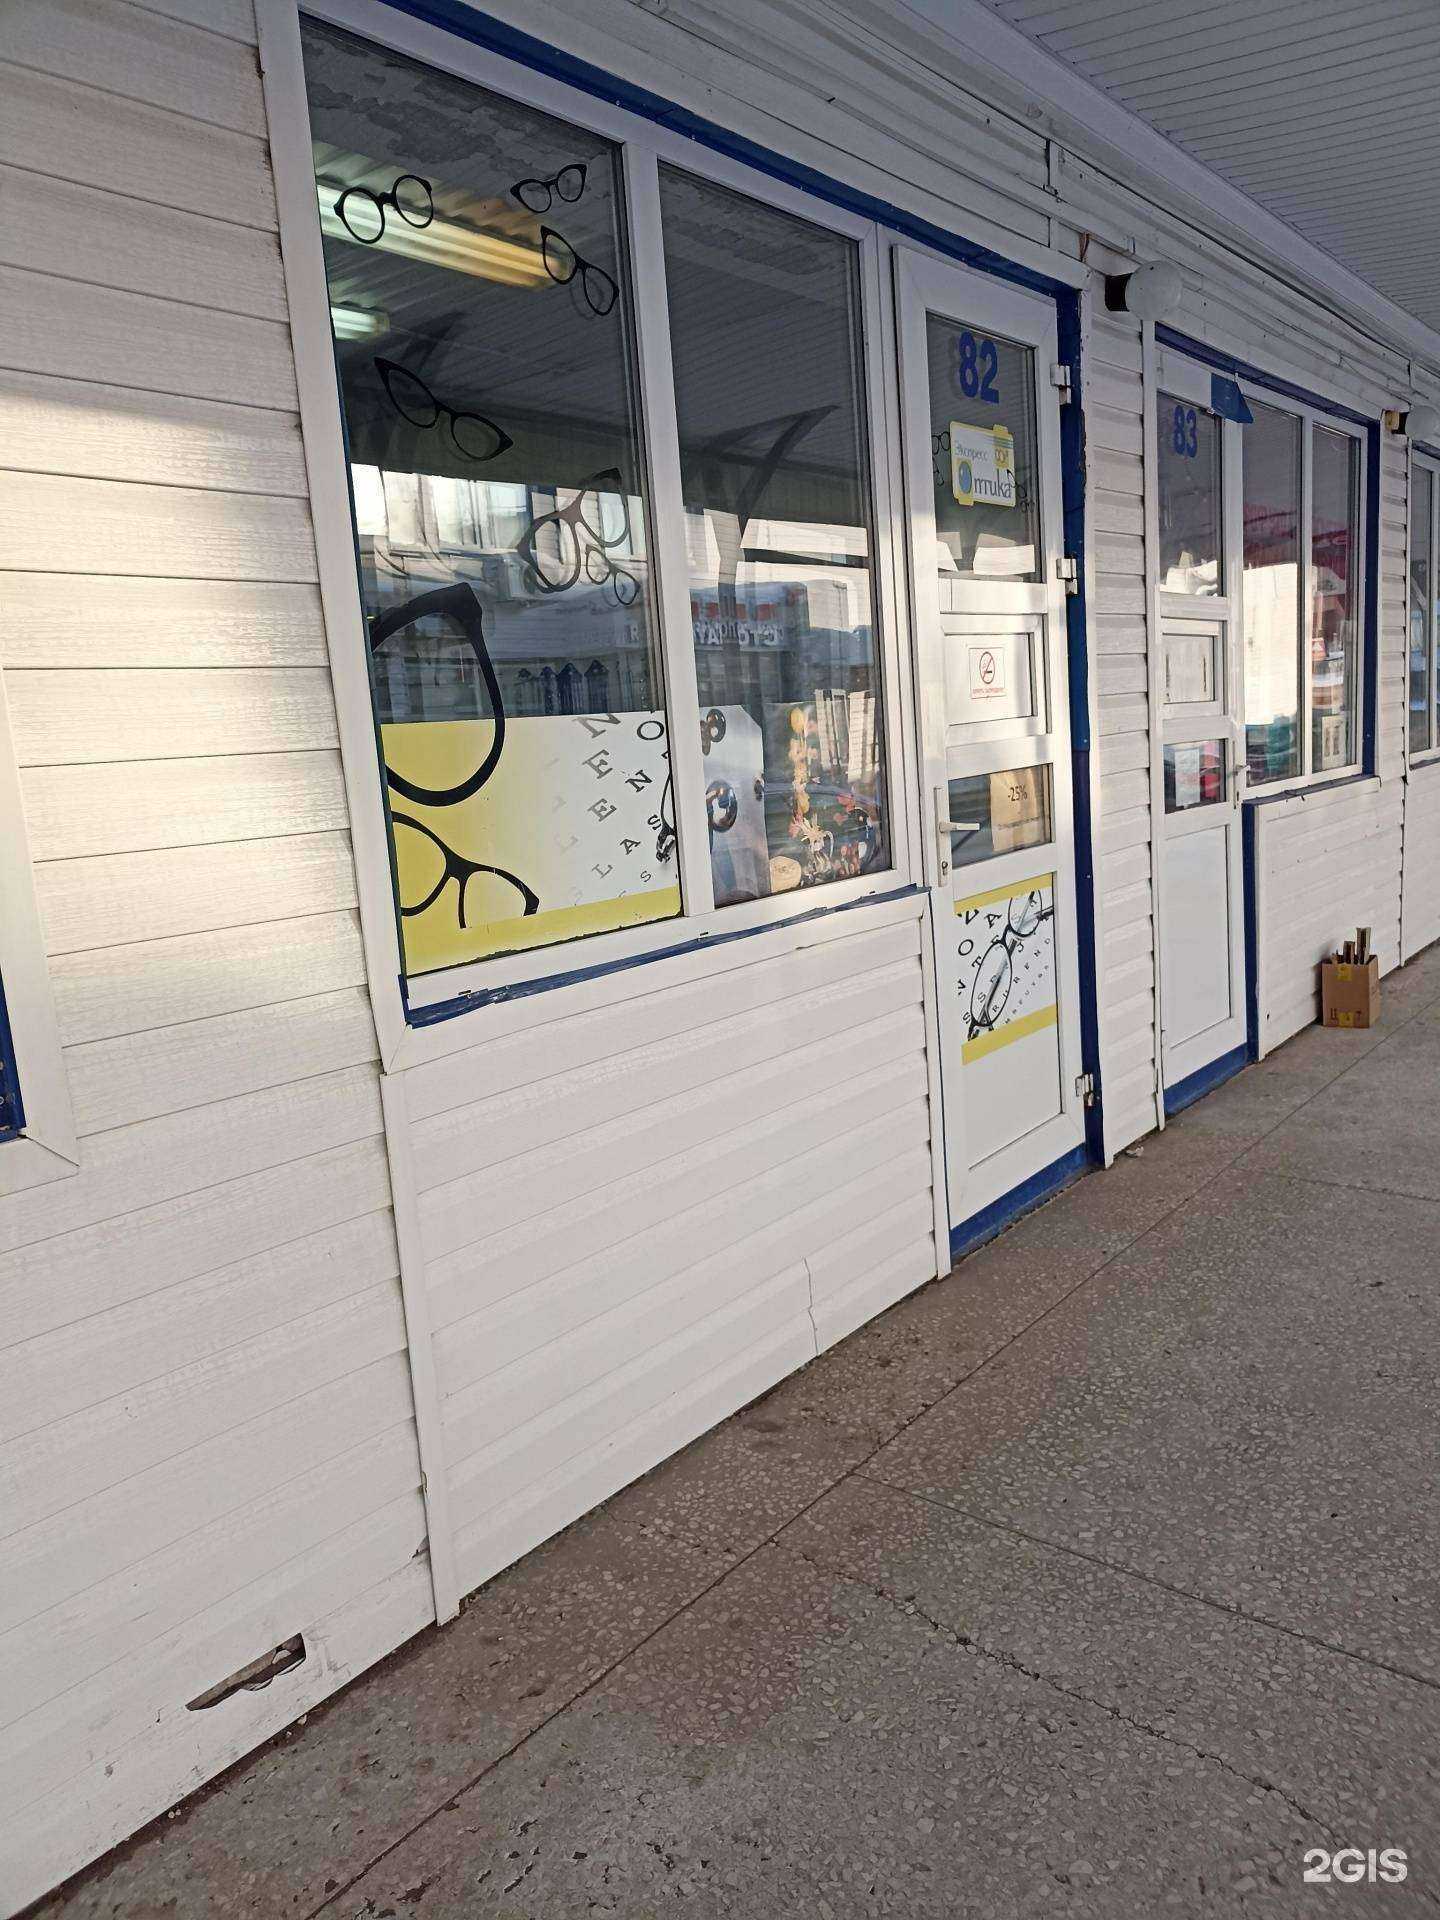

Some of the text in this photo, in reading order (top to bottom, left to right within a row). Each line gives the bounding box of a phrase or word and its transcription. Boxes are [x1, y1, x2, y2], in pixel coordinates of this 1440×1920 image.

[959, 332, 998, 403] 82
[1174, 405, 1197, 457] 83
[637, 720, 665, 741] O
[587, 769, 653, 822] E N
[1008, 784, 1028, 802] -25%
[591, 863, 613, 879] L
[619, 838, 641, 855] A
[984, 913, 1002, 928] A
